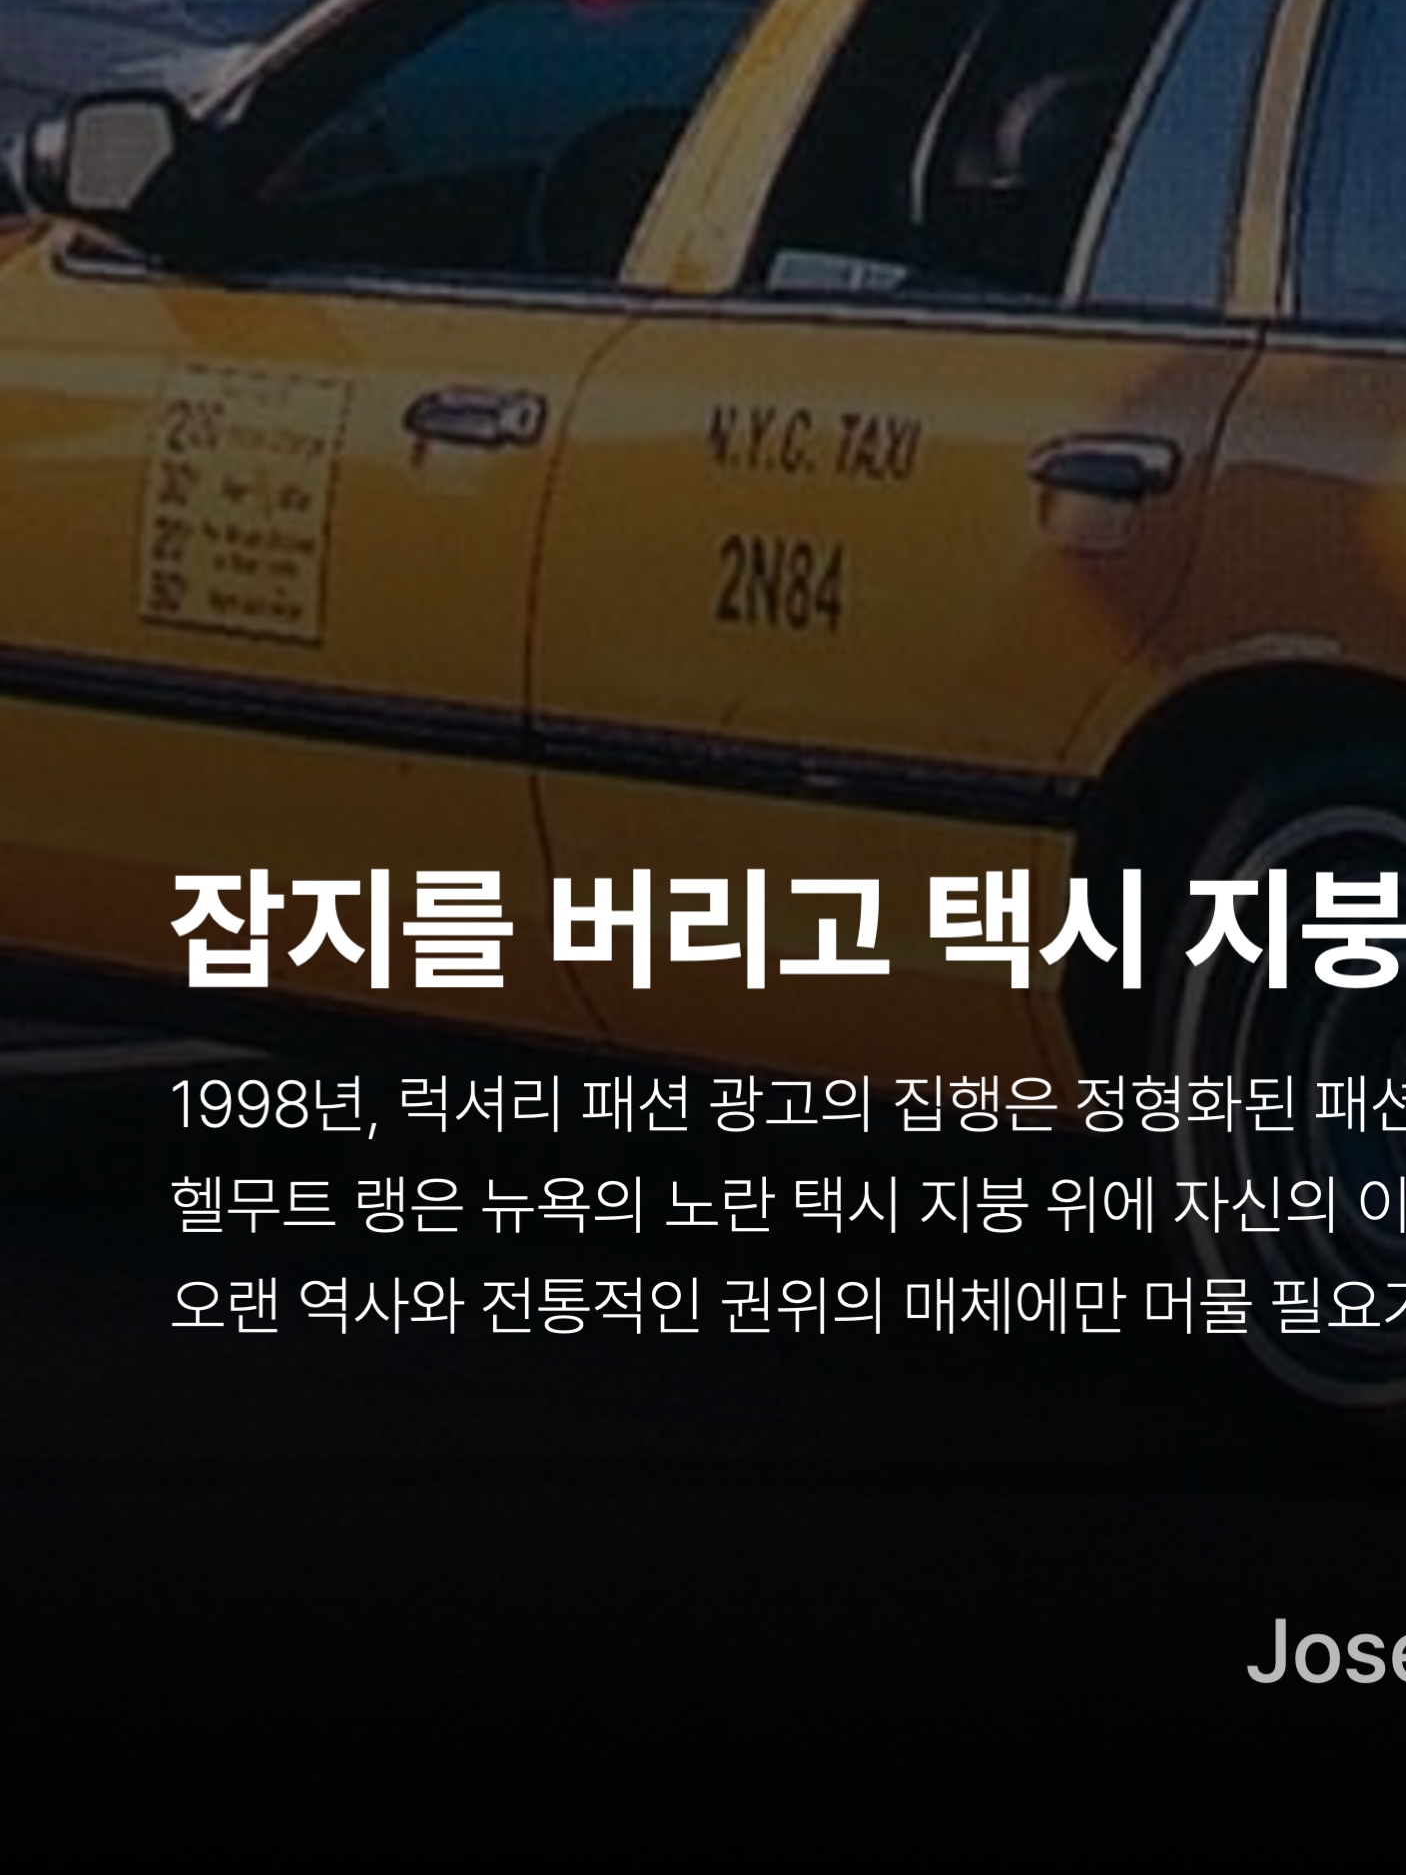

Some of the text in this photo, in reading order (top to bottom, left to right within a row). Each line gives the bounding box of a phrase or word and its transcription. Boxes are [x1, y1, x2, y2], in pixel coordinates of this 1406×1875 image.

[708, 406, 922, 480] N.Y.C. TAXI
[716, 534, 844, 633] 2N84
